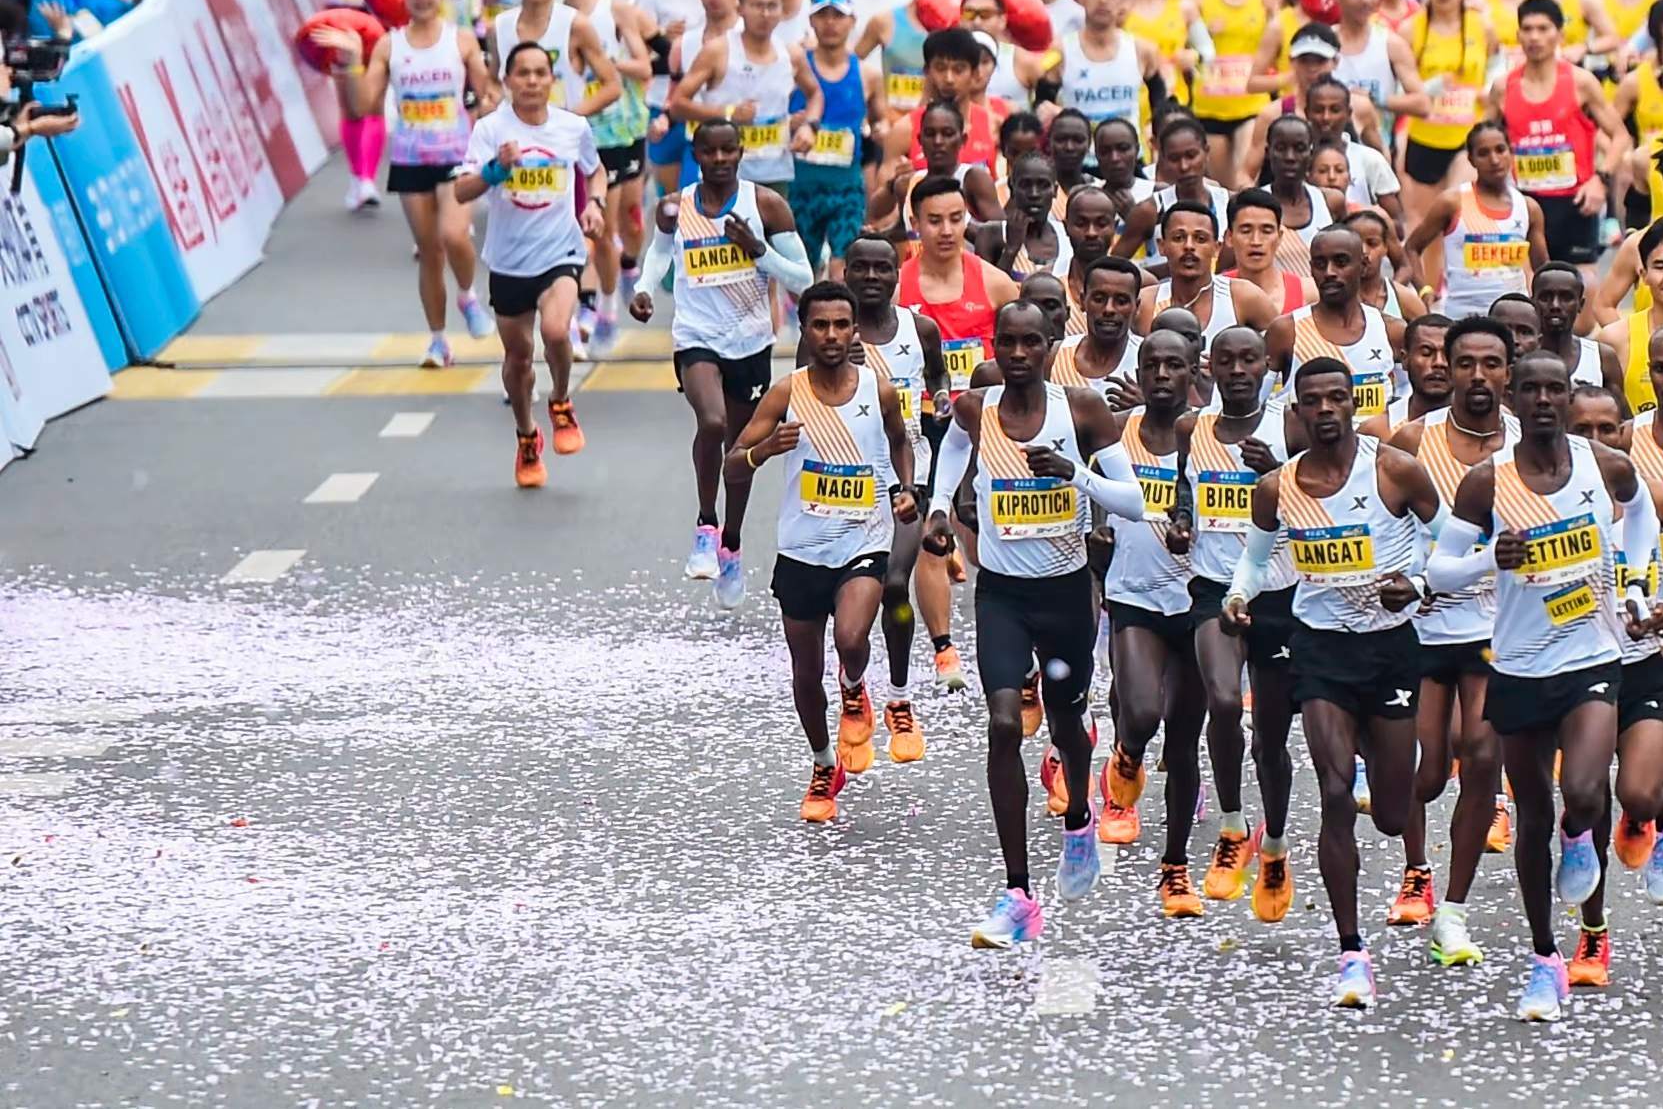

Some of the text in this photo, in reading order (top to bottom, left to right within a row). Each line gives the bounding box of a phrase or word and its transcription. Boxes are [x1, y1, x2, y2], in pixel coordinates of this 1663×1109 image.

[1074, 85, 1134, 103] PACER
[520, 168, 554, 185] 0556
[1471, 245, 1527, 261] BEKELE
[816, 477, 864, 499] NAGU
[1206, 486, 1254, 509] BIRG
[997, 490, 1071, 516] KIPROTICH
[1293, 540, 1364, 565] LANGAT
[1521, 530, 1593, 565] ETTING
[1550, 592, 1591, 618] LETTING
